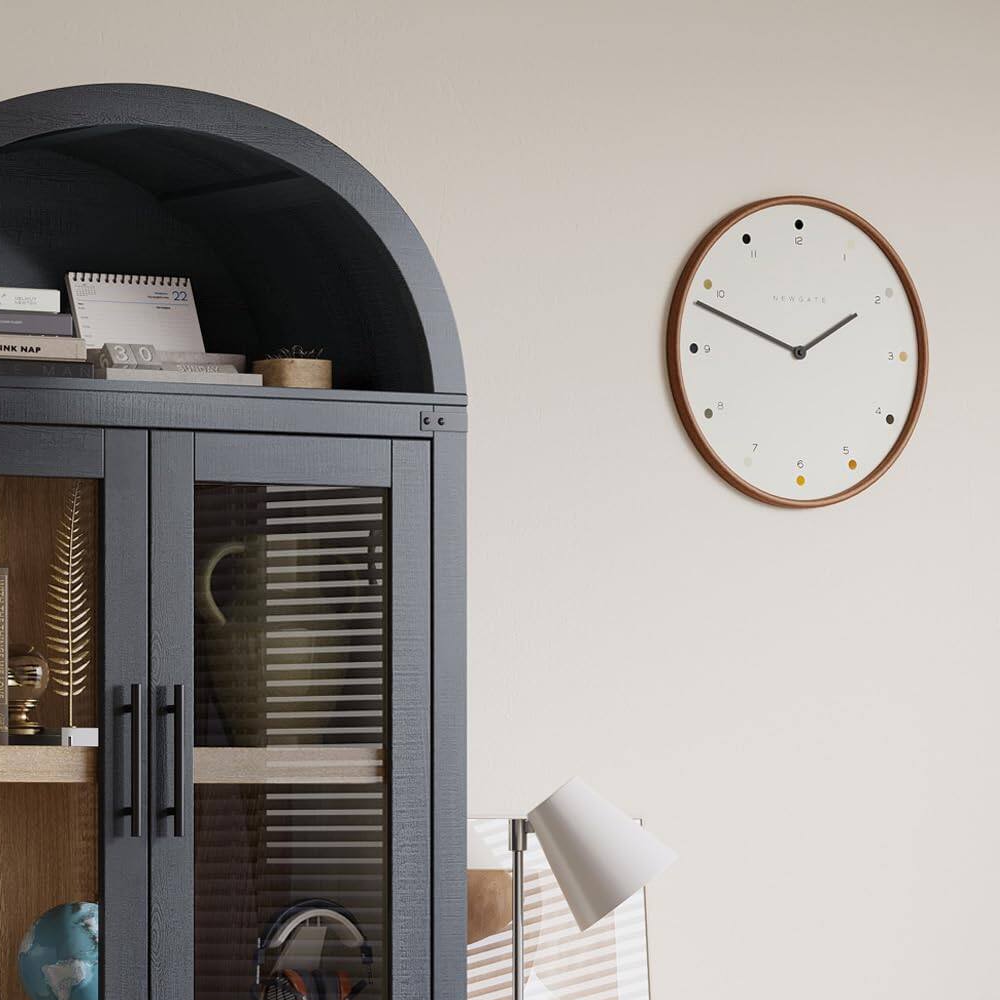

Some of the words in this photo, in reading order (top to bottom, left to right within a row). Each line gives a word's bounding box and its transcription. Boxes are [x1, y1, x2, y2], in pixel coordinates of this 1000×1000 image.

[794, 236, 803, 246] 12
[751, 250, 757, 259] 11
[171, 290, 189, 302] 22
[716, 289, 725, 299] 10
[773, 295, 827, 304] NEWGATE
[874, 295, 881, 305] 2
[20, 345, 42, 353] NAP
[704, 344, 711, 353] 9
[887, 351, 894, 361] 3
[42, 364, 90, 377] MAN
[717, 401, 724, 411] 8
[875, 406, 882, 415] 4
[752, 443, 758, 452] 7
[842, 446, 850, 455] 5
[797, 459, 805, 469] 6
